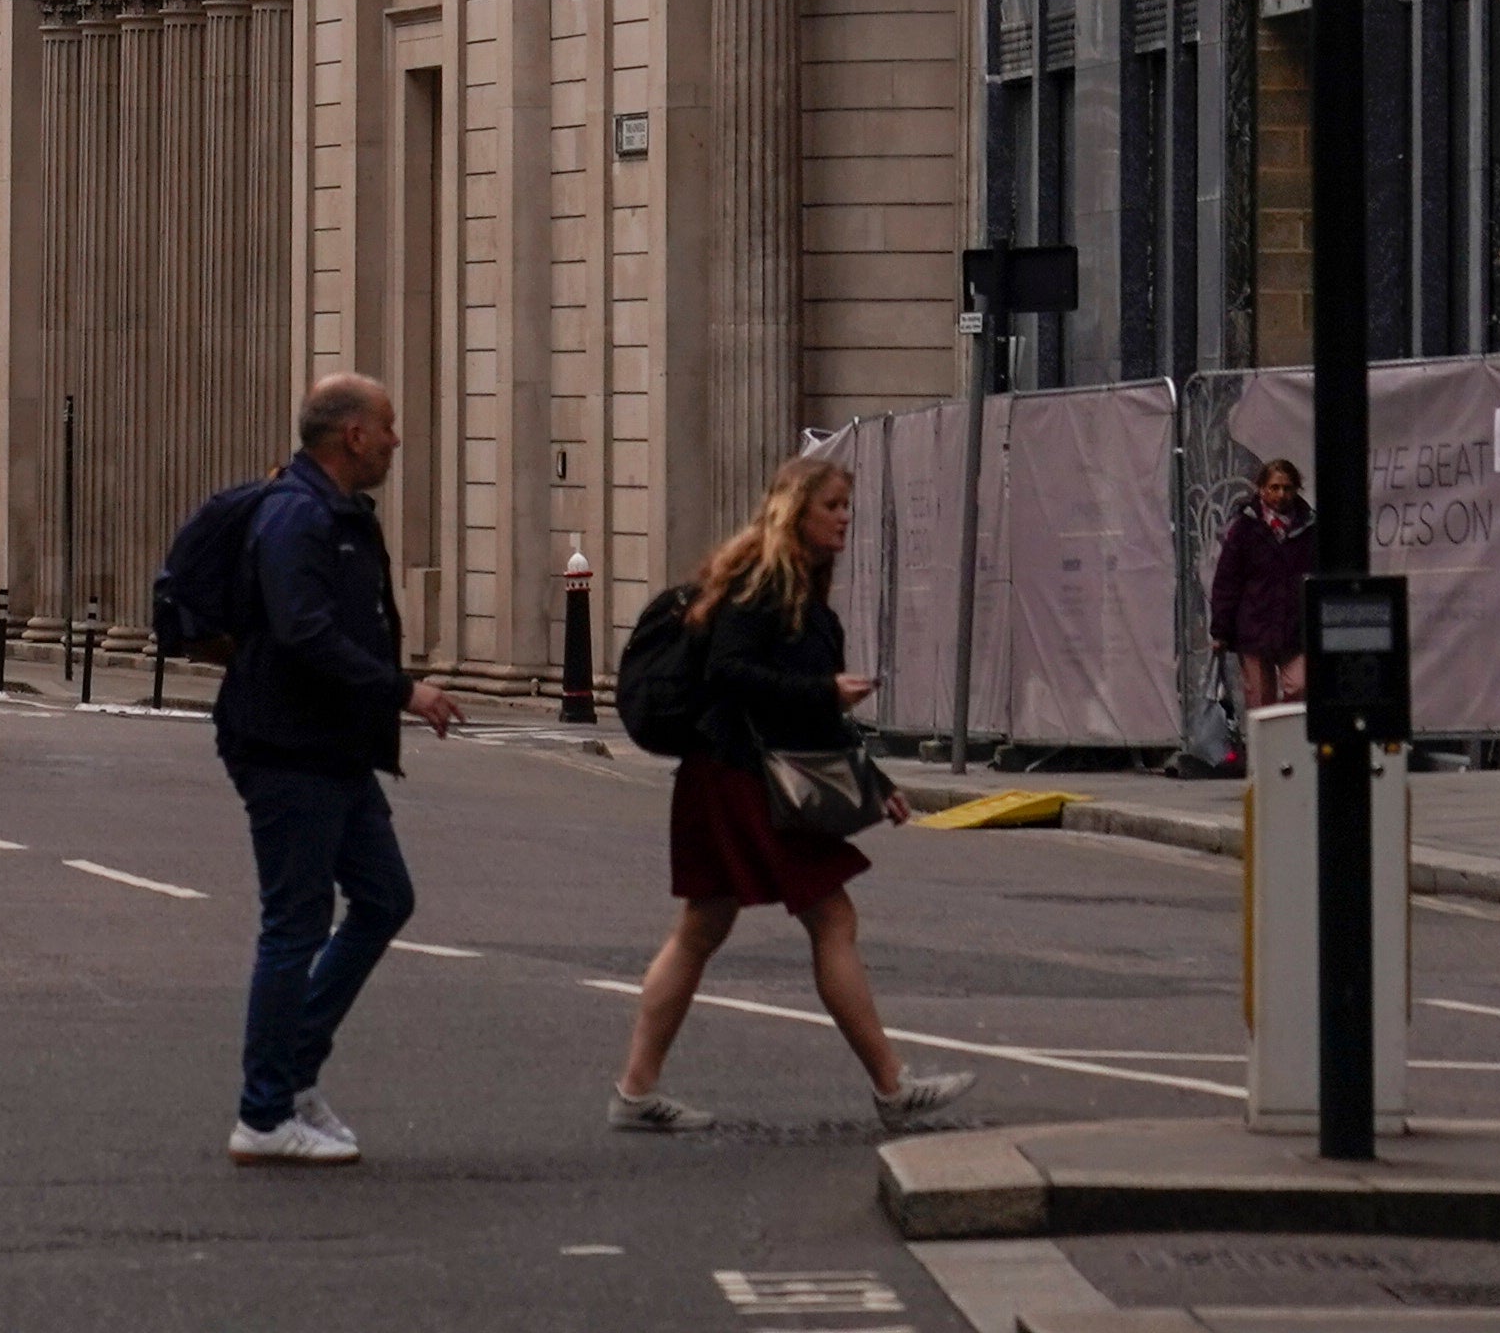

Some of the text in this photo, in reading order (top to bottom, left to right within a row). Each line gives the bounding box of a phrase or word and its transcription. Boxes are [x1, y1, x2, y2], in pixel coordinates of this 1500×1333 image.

[1372, 440, 1490, 491] HE BEAT
[1374, 498, 1493, 547] OES ON
